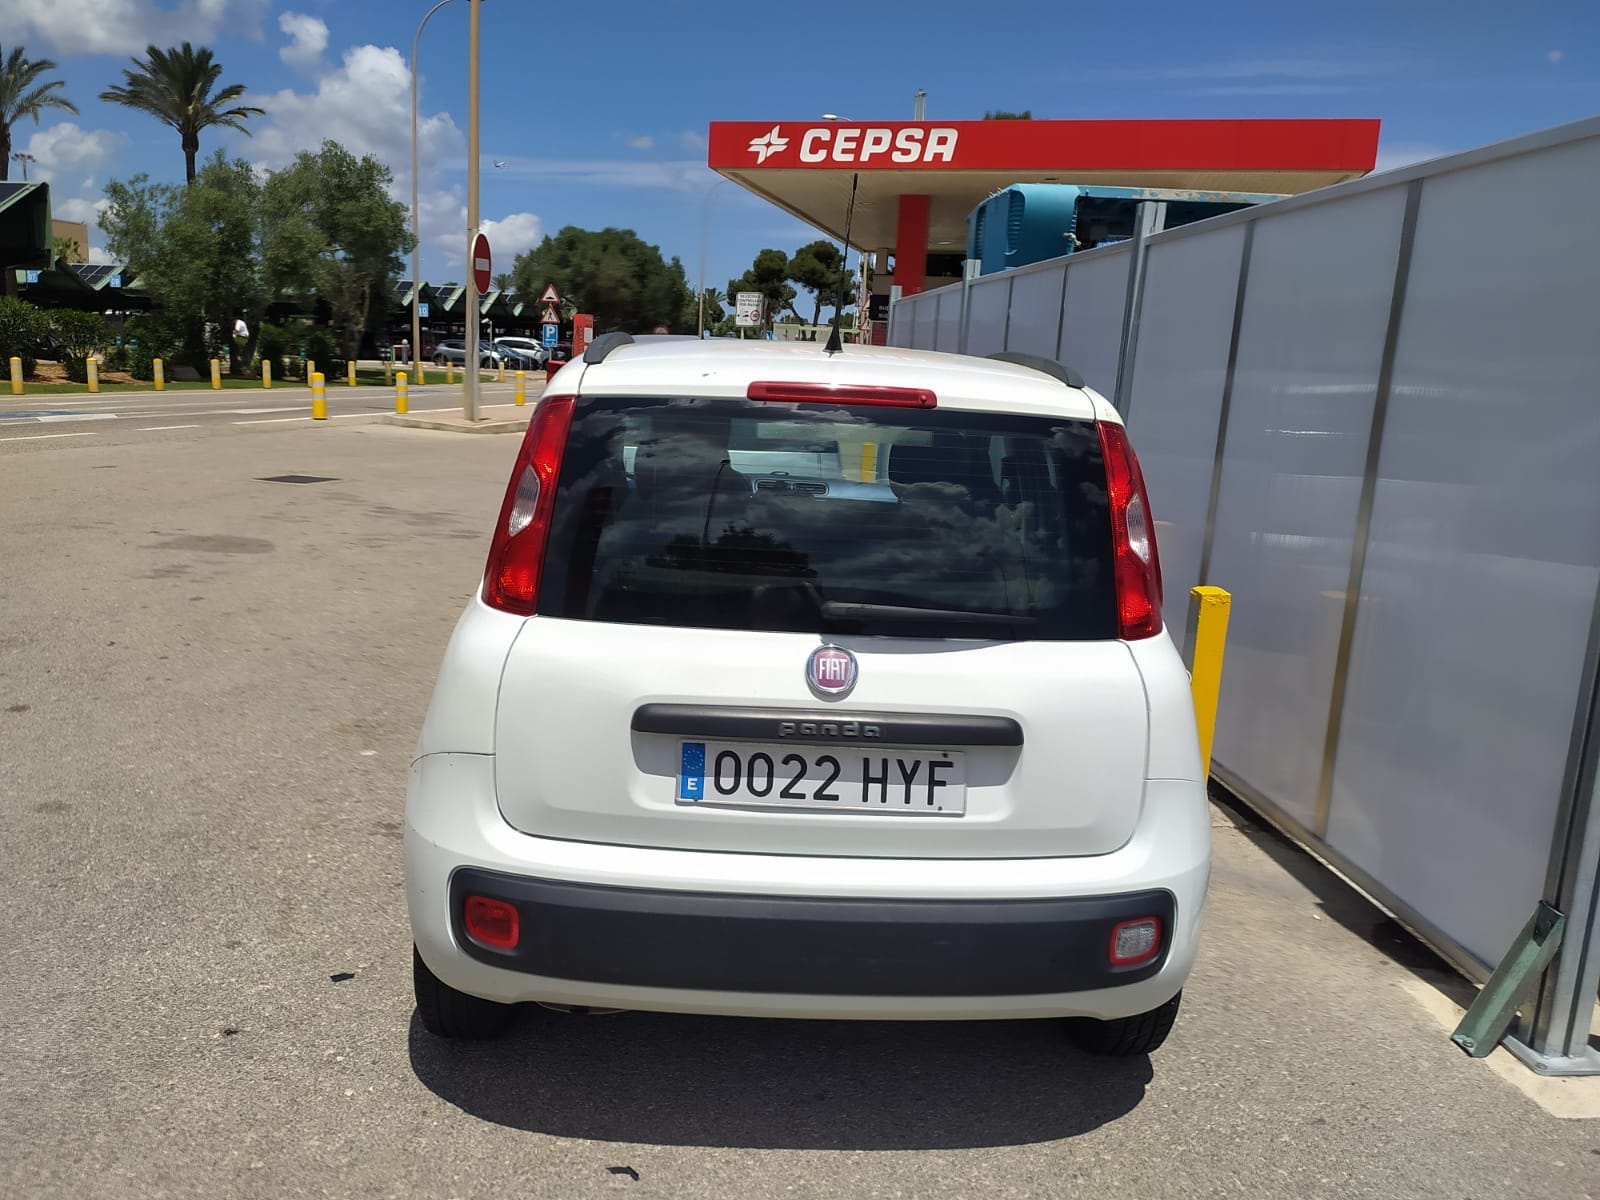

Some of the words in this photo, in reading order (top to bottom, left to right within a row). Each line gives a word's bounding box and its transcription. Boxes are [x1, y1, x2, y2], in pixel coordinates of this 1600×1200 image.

[799, 128, 959, 163] CEPSA
[819, 657, 848, 681] FIAT
[779, 721, 882, 738] panda
[687, 778, 697, 791] E
[714, 750, 841, 802] 0022
[862, 757, 954, 806] HYF
